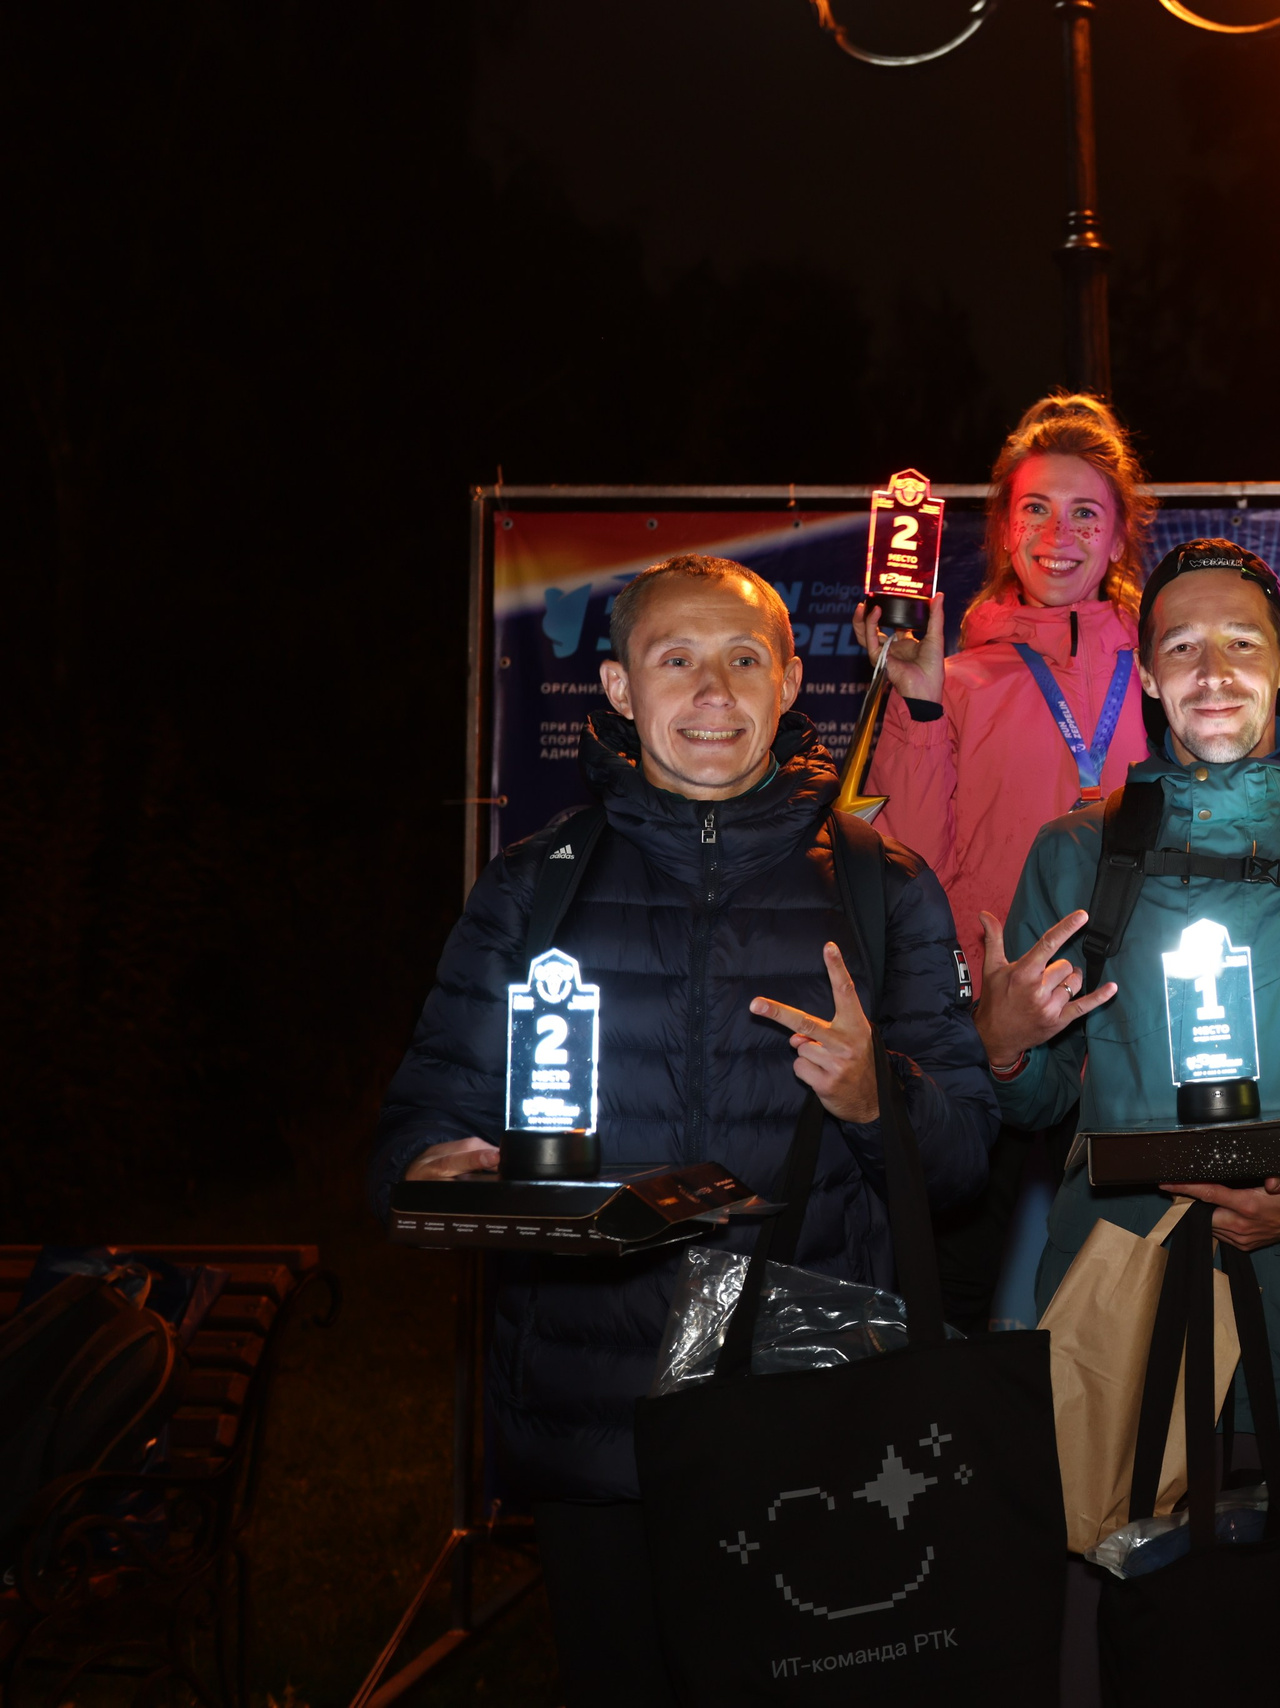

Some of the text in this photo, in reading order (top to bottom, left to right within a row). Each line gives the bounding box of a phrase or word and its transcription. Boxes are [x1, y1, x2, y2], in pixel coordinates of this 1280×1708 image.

[890, 515, 919, 551] 2
[887, 553, 918, 564] МЕСТО
[806, 682, 836, 695] RUN
[540, 721, 567, 733] ПРИ
[815, 721, 837, 733] ОЙ
[1057, 701, 1082, 739] ZEPPELIN
[1058, 721, 1073, 739] RUN
[540, 748, 579, 760] АДМИ
[1194, 973, 1225, 1020] 1
[534, 1014, 568, 1065] 2
[771, 1627, 959, 1679] ИТ-команда РТК
